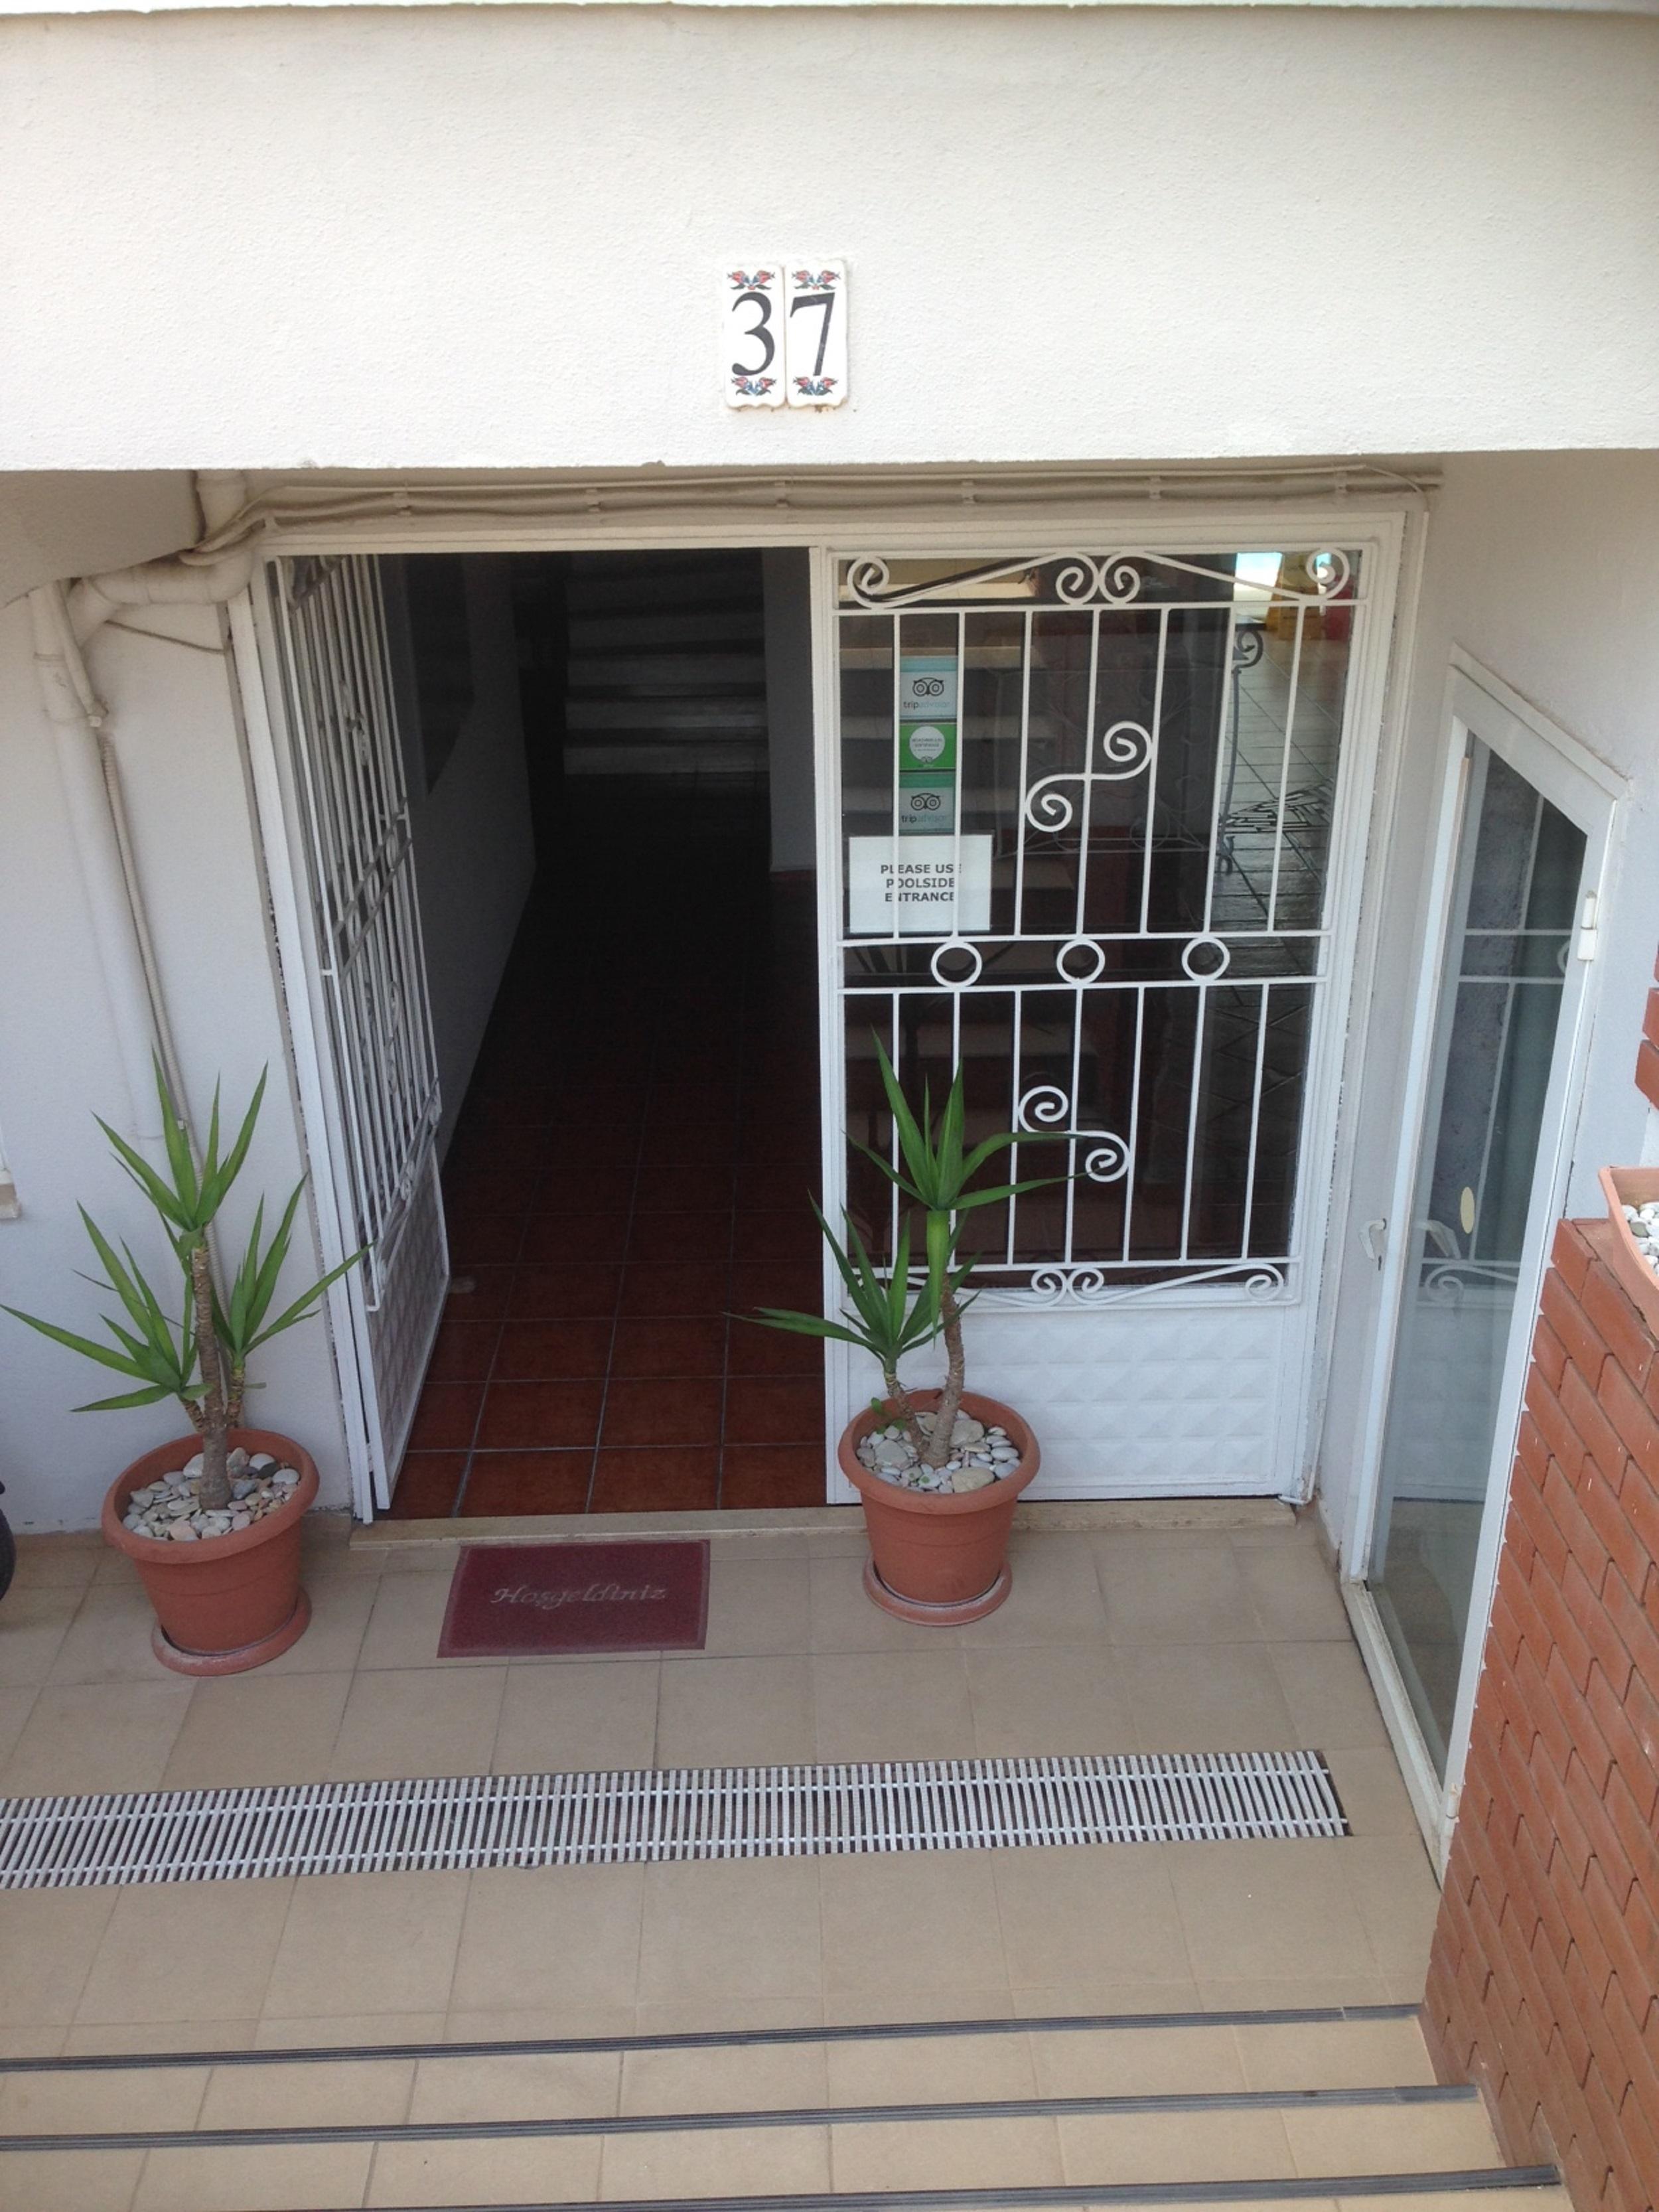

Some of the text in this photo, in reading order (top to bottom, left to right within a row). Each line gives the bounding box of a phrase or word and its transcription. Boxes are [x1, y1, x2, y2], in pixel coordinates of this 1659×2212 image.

[732, 291, 835, 376] 37
[881, 863, 961, 874] PLEASE US
[886, 877, 954, 889] POOLSIDE
